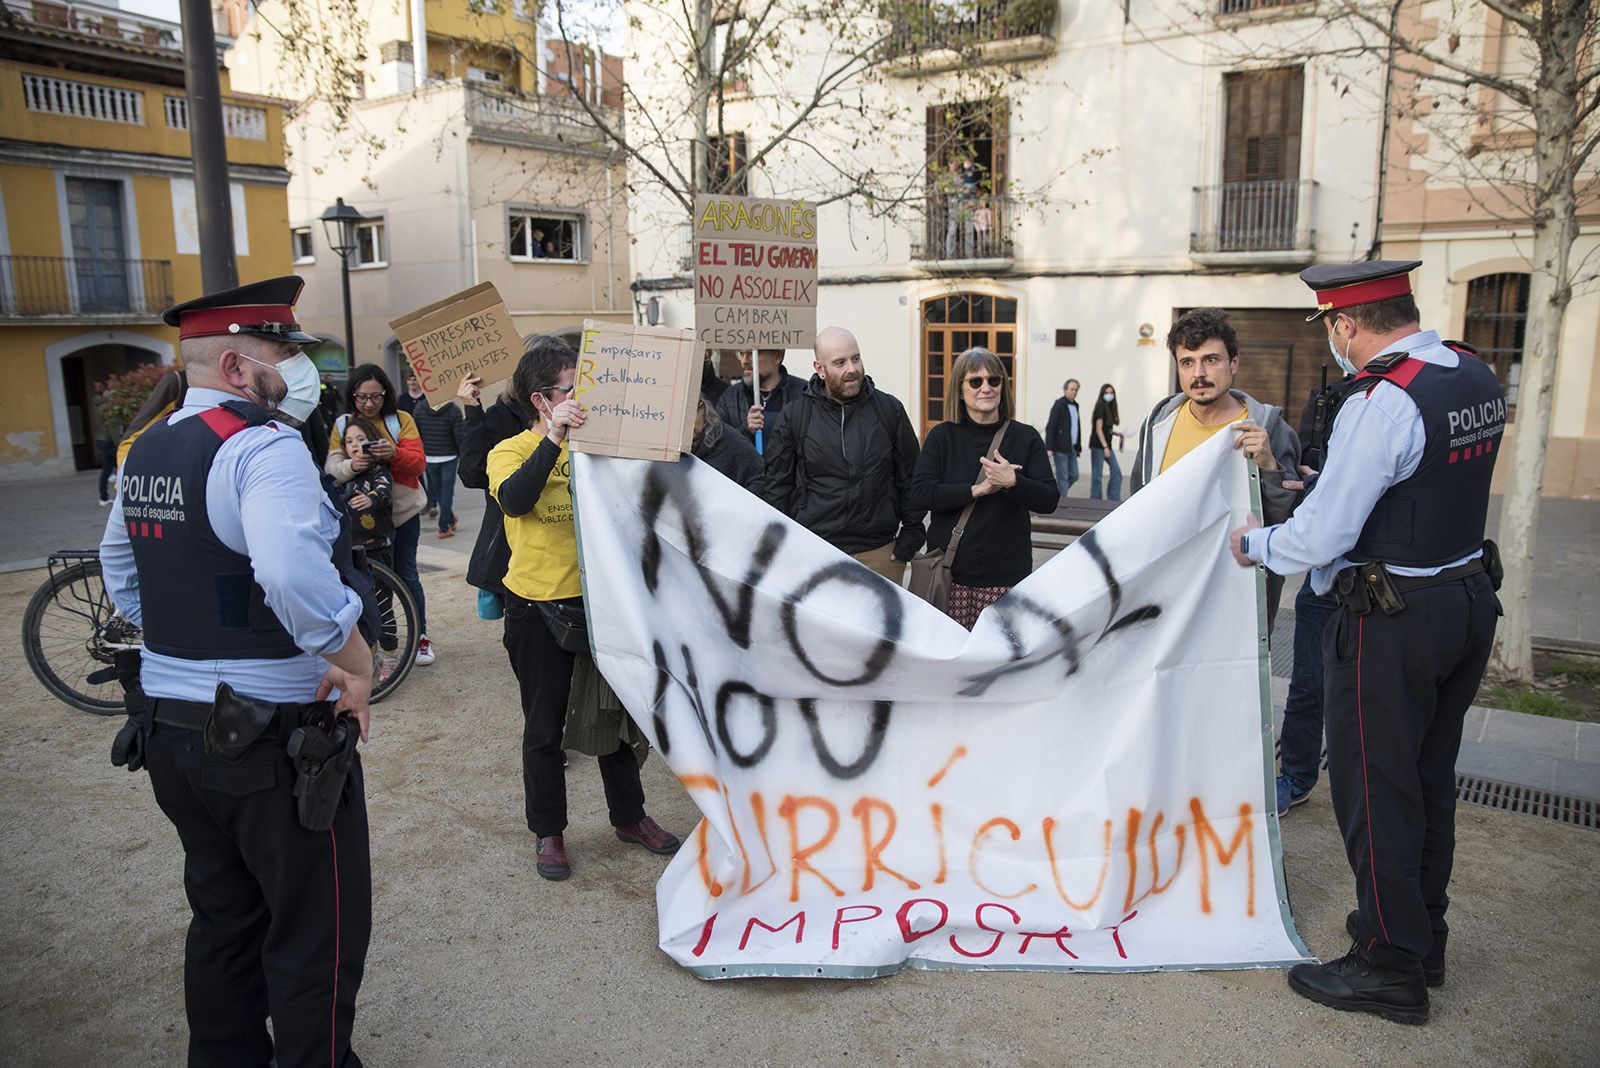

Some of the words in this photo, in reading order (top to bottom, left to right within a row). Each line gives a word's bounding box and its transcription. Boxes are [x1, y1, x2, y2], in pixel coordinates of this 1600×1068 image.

[698, 200, 816, 239] ARAGONÈS
[699, 242, 727, 266] EL
[728, 243, 764, 268] TEU
[767, 245, 818, 269] GOVERN
[700, 274, 724, 298] NO
[730, 274, 813, 303] ASSOLEIX
[405, 313, 496, 360] EMPRESARIS
[583, 329, 662, 360] Empresaris
[701, 328, 804, 345] CESSAMENT
[413, 330, 502, 377] RETALLADORS
[422, 347, 509, 392] CAPITALISTES
[1448, 398, 1505, 435] POLICIA
[1450, 433, 1477, 448] mossos
[122, 475, 184, 505] POLICIA
[142, 504, 185, 522] d'esquadra
[640, 455, 904, 688] NO
